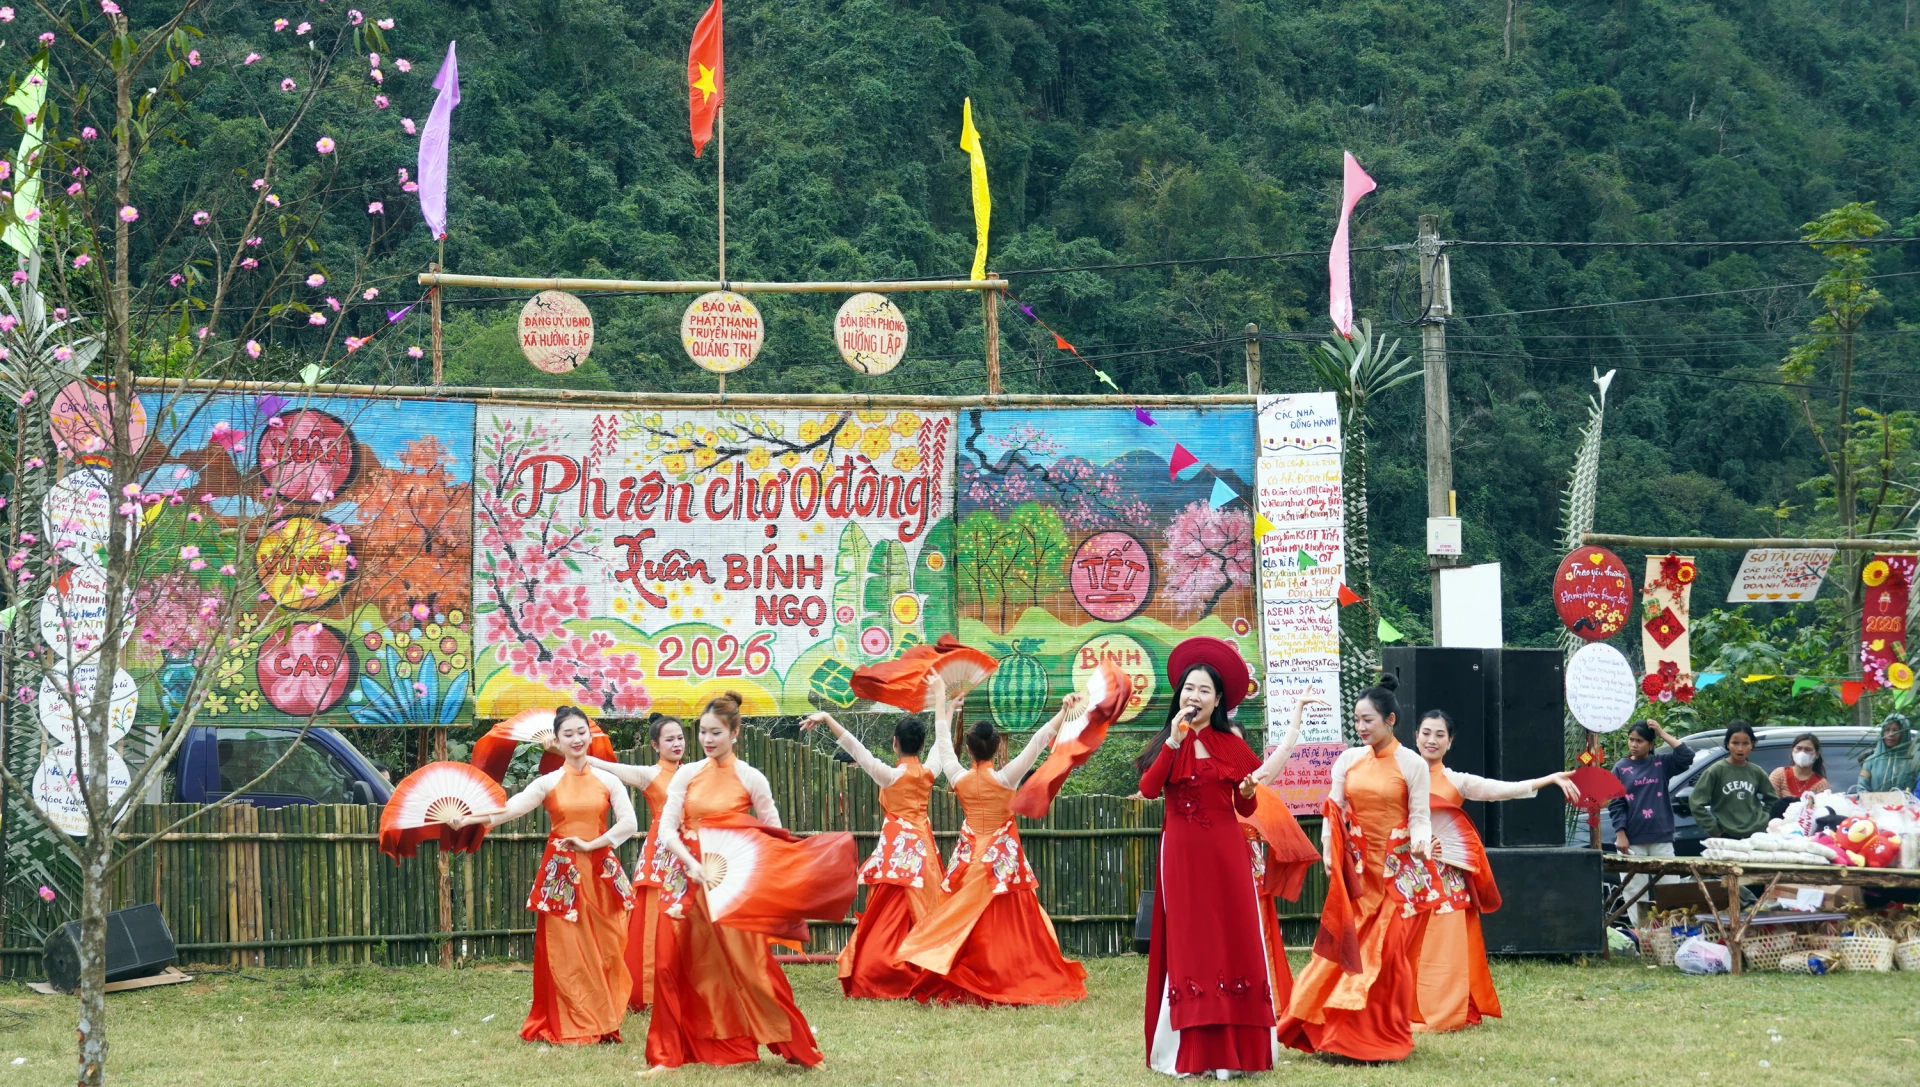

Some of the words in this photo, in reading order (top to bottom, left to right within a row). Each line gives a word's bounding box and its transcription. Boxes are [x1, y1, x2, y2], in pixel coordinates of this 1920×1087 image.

[702, 299, 724, 313] BÁO
[728, 301, 742, 313] VÀ
[525, 313, 552, 327] ĐẢNG
[566, 316, 590, 327] UBND
[690, 313, 719, 328] PHÁT
[720, 316, 758, 328] THANH
[840, 310, 858, 328] ĐỒN
[859, 314, 877, 329] BIÊN
[878, 317, 905, 332] PHÒNG
[524, 330, 538, 347] XÃ
[540, 328, 570, 347] HƯỚNG
[573, 330, 590, 349] LẬP
[688, 322, 728, 340] TRUYỀN
[730, 327, 757, 340] HÌNH
[732, 342, 752, 362] TRỊ
[880, 333, 901, 358] LẬP
[82, 400, 100, 412] NÀ
[1274, 409, 1292, 421] CÁC
[1296, 405, 1314, 418] NHÀ
[1290, 418, 1312, 430] ĐỒNG
[1314, 416, 1337, 428] HÀNH
[271, 429, 352, 464] XUÂN
[513, 455, 699, 522] Phiên
[704, 460, 789, 538] chợ
[789, 466, 821, 521] 0
[824, 454, 932, 542] đồng
[260, 545, 332, 577] VÙNG
[1770, 550, 1790, 562] TÀI
[1792, 550, 1834, 562] CHÍNH
[613, 527, 716, 609] Xuân
[723, 542, 825, 591] BÍNH
[1077, 540, 1145, 592] TẾT
[1744, 565, 1761, 574] CÁC
[1744, 582, 1780, 590] DOANH
[1784, 580, 1818, 590] NGHIỆP
[75, 594, 100, 604] TNHH
[754, 594, 828, 637] NGỌ
[1266, 606, 1295, 616] ASENA
[1298, 605, 1316, 616] SPA
[1866, 616, 1902, 632] 2026
[657, 634, 773, 678] 2026
[1079, 641, 1142, 669] BÍNH
[273, 653, 335, 677] CAO
